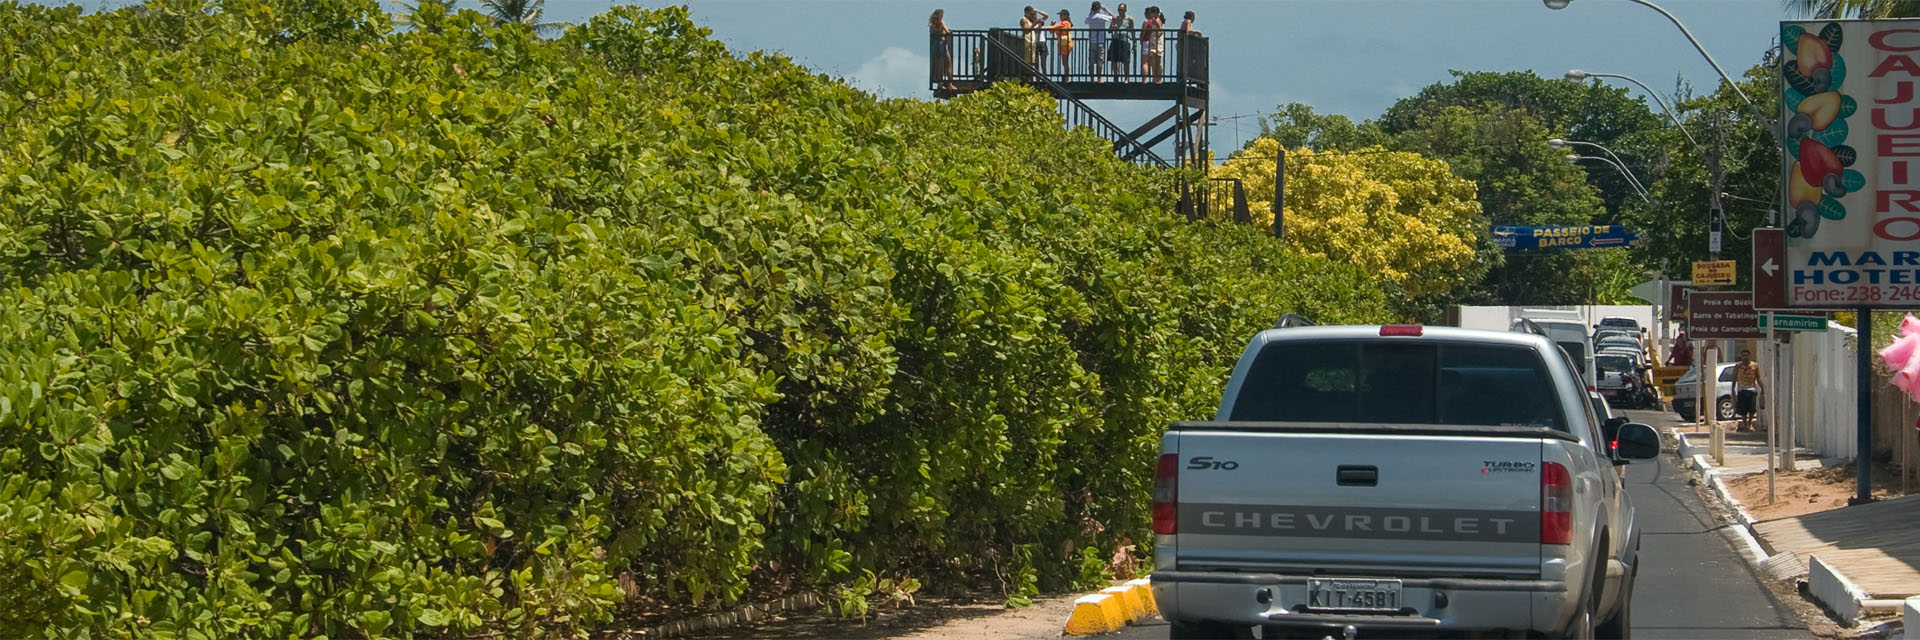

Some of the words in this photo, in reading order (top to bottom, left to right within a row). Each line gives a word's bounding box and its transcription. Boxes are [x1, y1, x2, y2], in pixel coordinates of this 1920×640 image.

[1868, 29, 1920, 240] CAJUEIRO
[1533, 226, 1590, 238] PASSEIO
[1593, 225, 1610, 235] DE
[1538, 236, 1582, 248] BARCO
[1794, 269, 1920, 285] HOTE
[1774, 319, 1818, 328] arnamirim
[1187, 456, 1239, 470] S10
[1202, 511, 1515, 534] CHEVROLET
